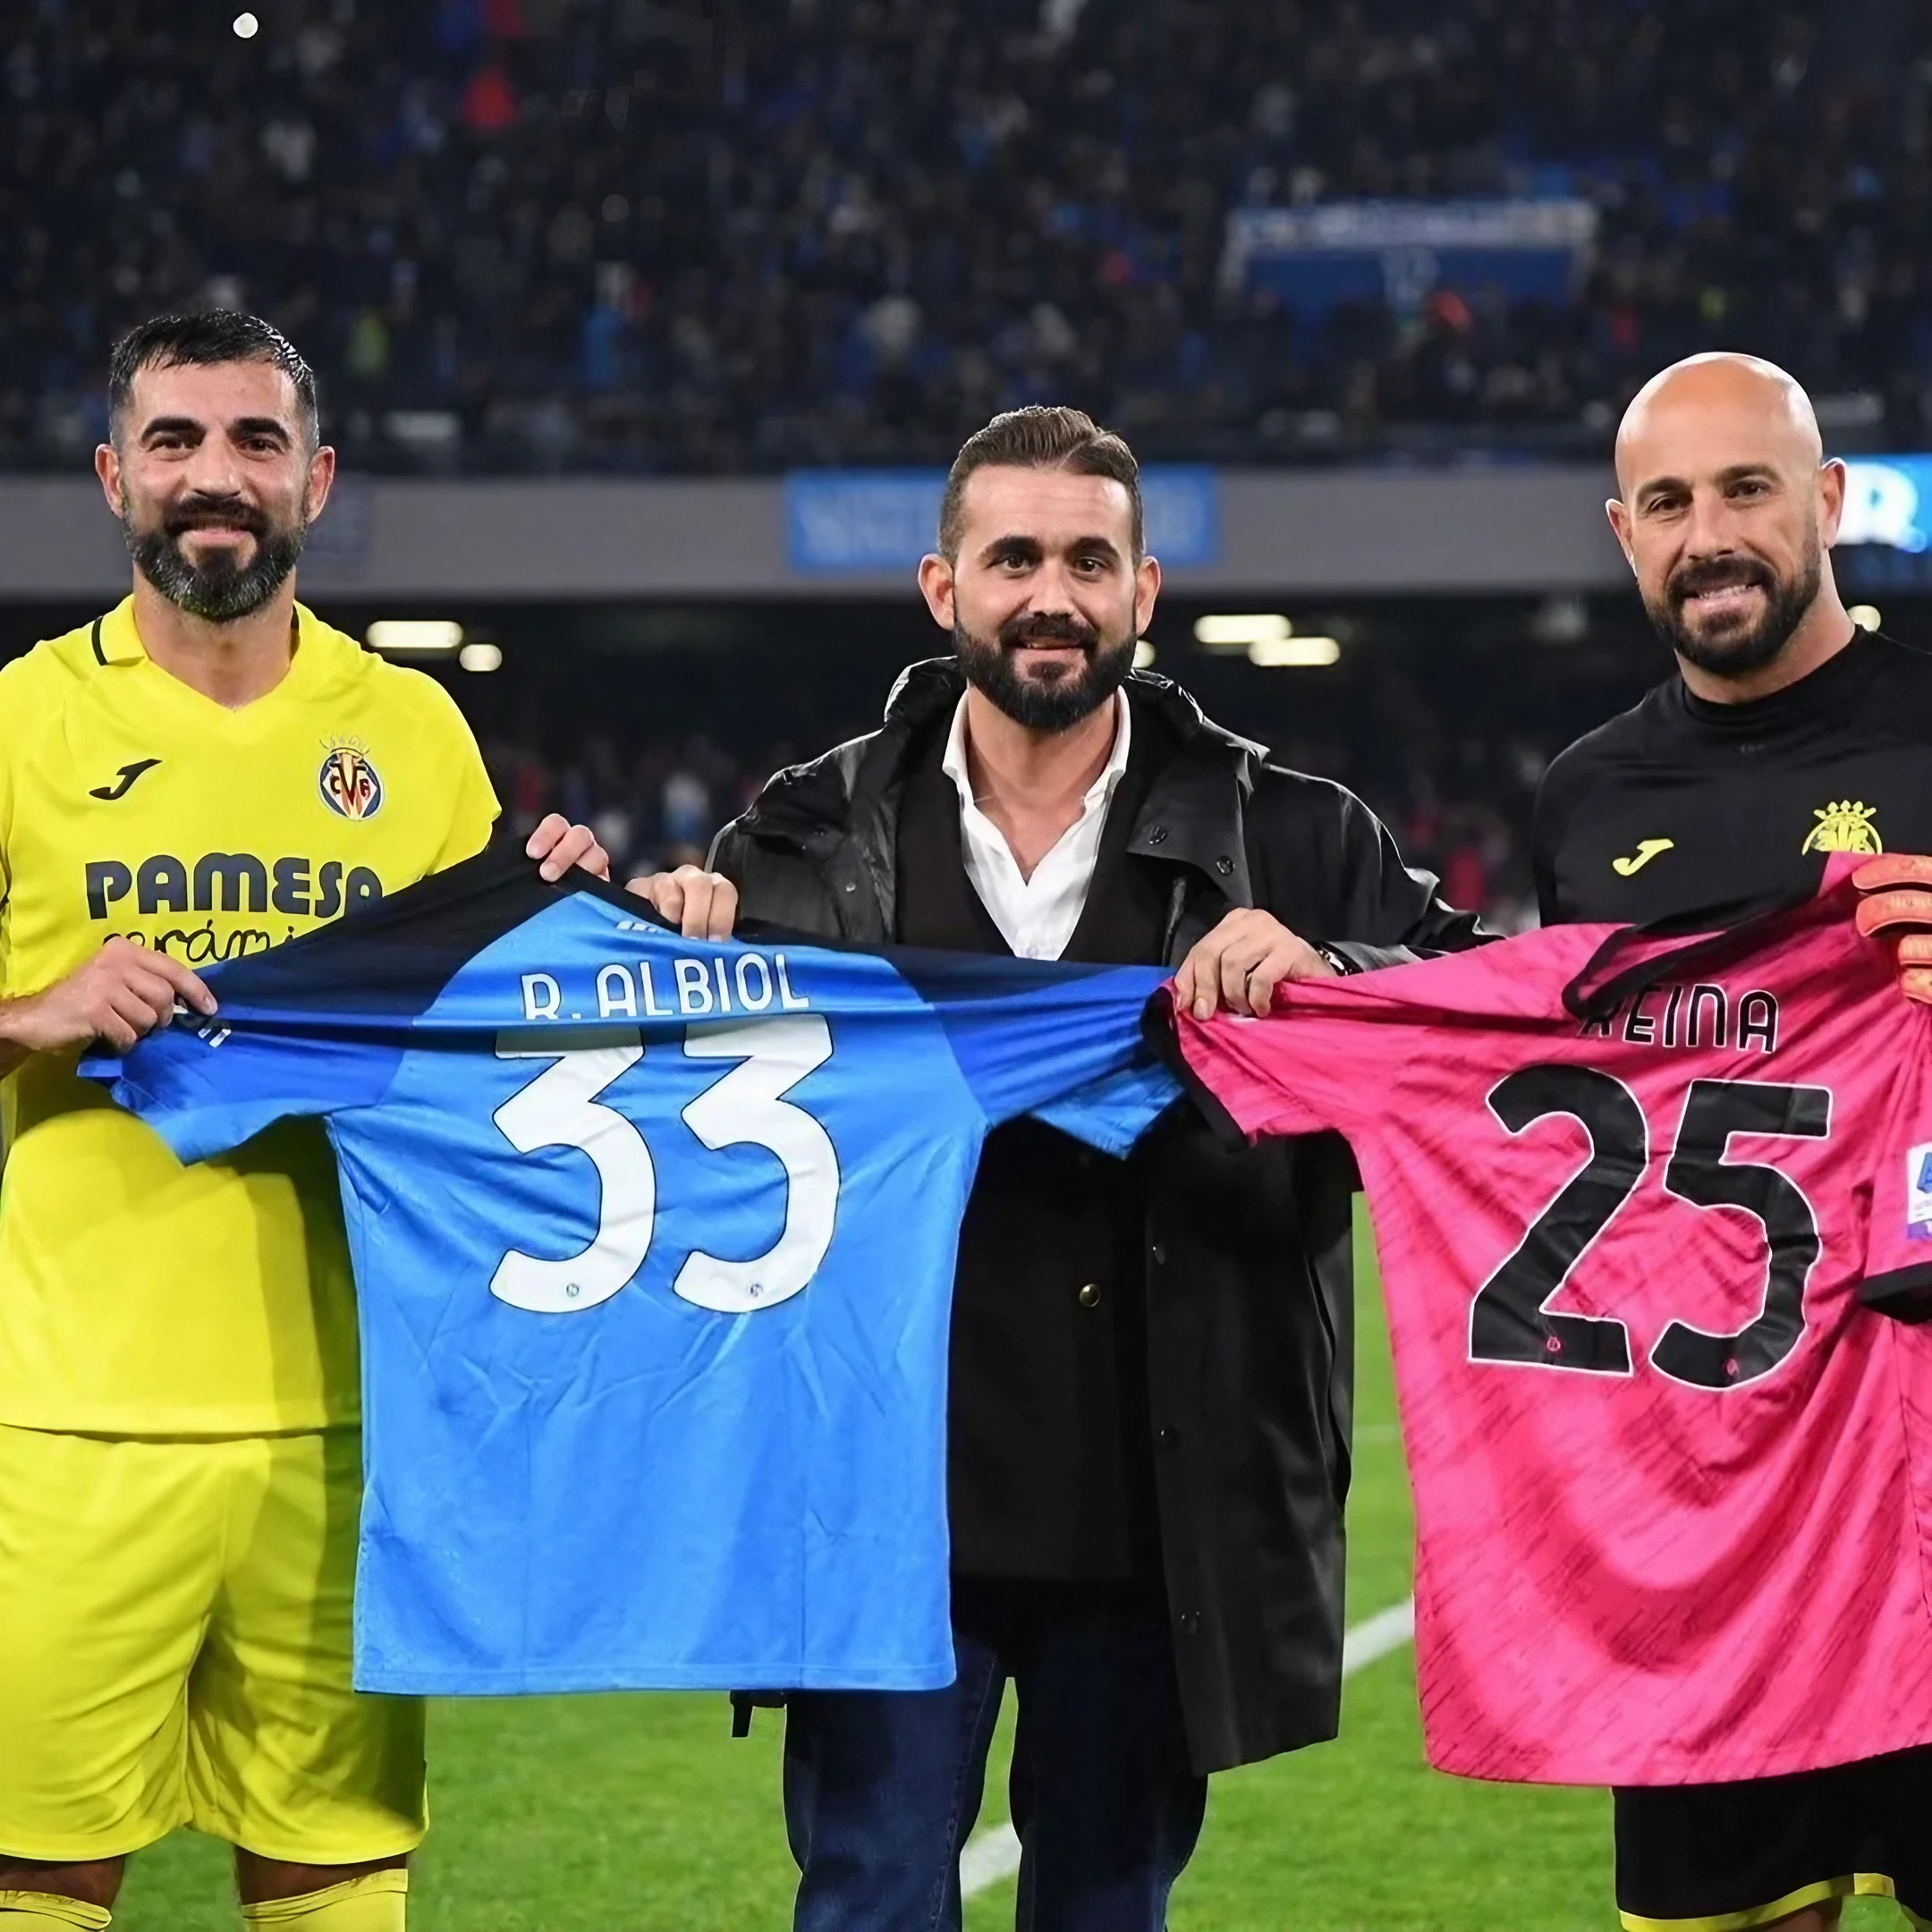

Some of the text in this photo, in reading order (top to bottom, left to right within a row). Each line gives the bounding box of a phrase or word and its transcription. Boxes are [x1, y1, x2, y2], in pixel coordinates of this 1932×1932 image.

[85, 852, 383, 919] PAMESA
[521, 953, 809, 1020] R. ALBIOL
[489, 1013, 842, 1313] 33
[1467, 1063, 1832, 1391] 25
